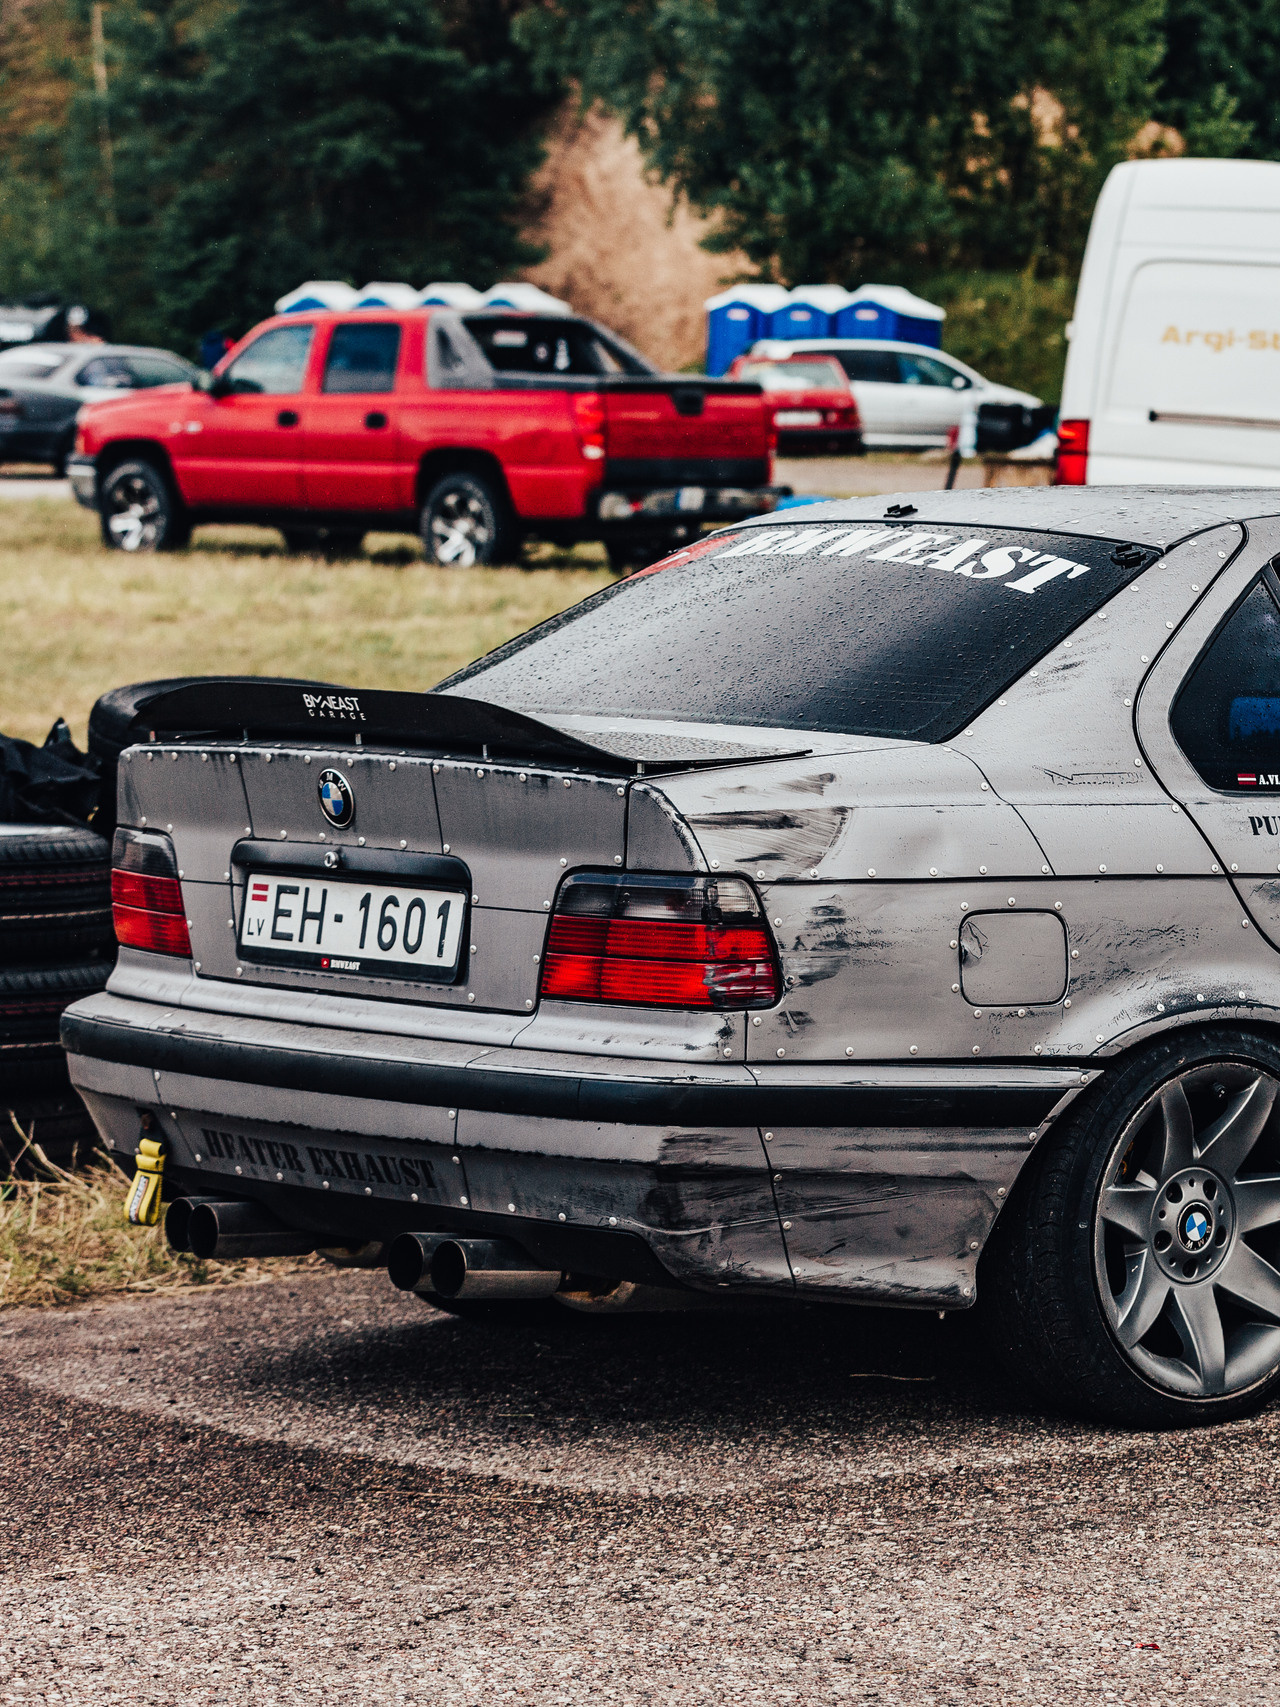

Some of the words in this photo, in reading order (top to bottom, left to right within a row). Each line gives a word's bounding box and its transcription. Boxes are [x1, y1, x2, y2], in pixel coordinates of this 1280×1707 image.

[713, 529, 1090, 594] BMWEAST
[302, 693, 360, 711] BMWEAST
[308, 708, 366, 720] GARAGE
[247, 917, 265, 936] LV
[271, 884, 451, 958] EH-1601
[201, 1128, 306, 1173] HEATER
[306, 1146, 437, 1189] EXHAUST
